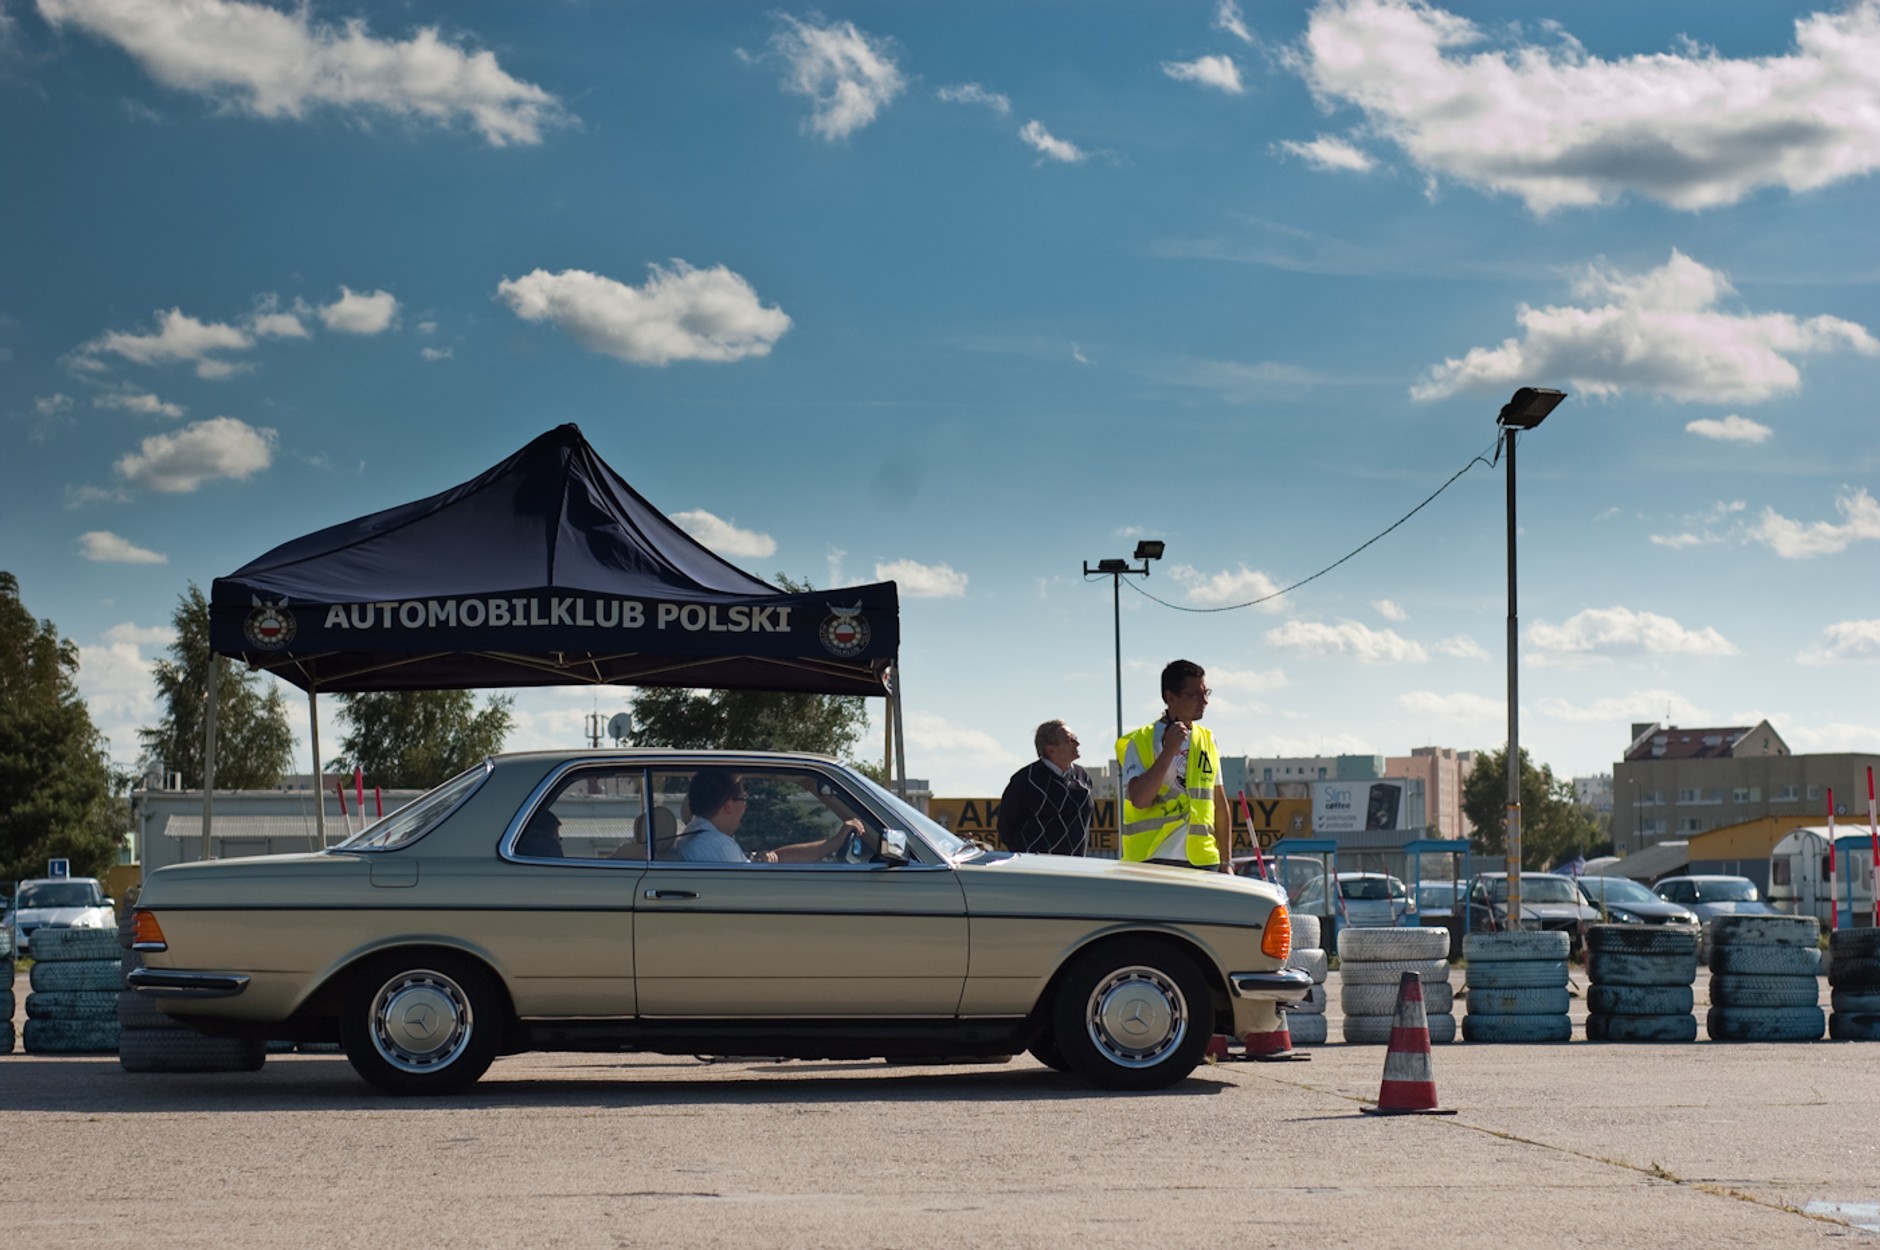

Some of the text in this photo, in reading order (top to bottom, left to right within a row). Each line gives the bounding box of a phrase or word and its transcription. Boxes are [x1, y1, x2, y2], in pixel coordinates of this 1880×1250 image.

[323, 597, 792, 633] AUTOMOBILKLUB POLSKI
[54, 862, 63, 875] L
